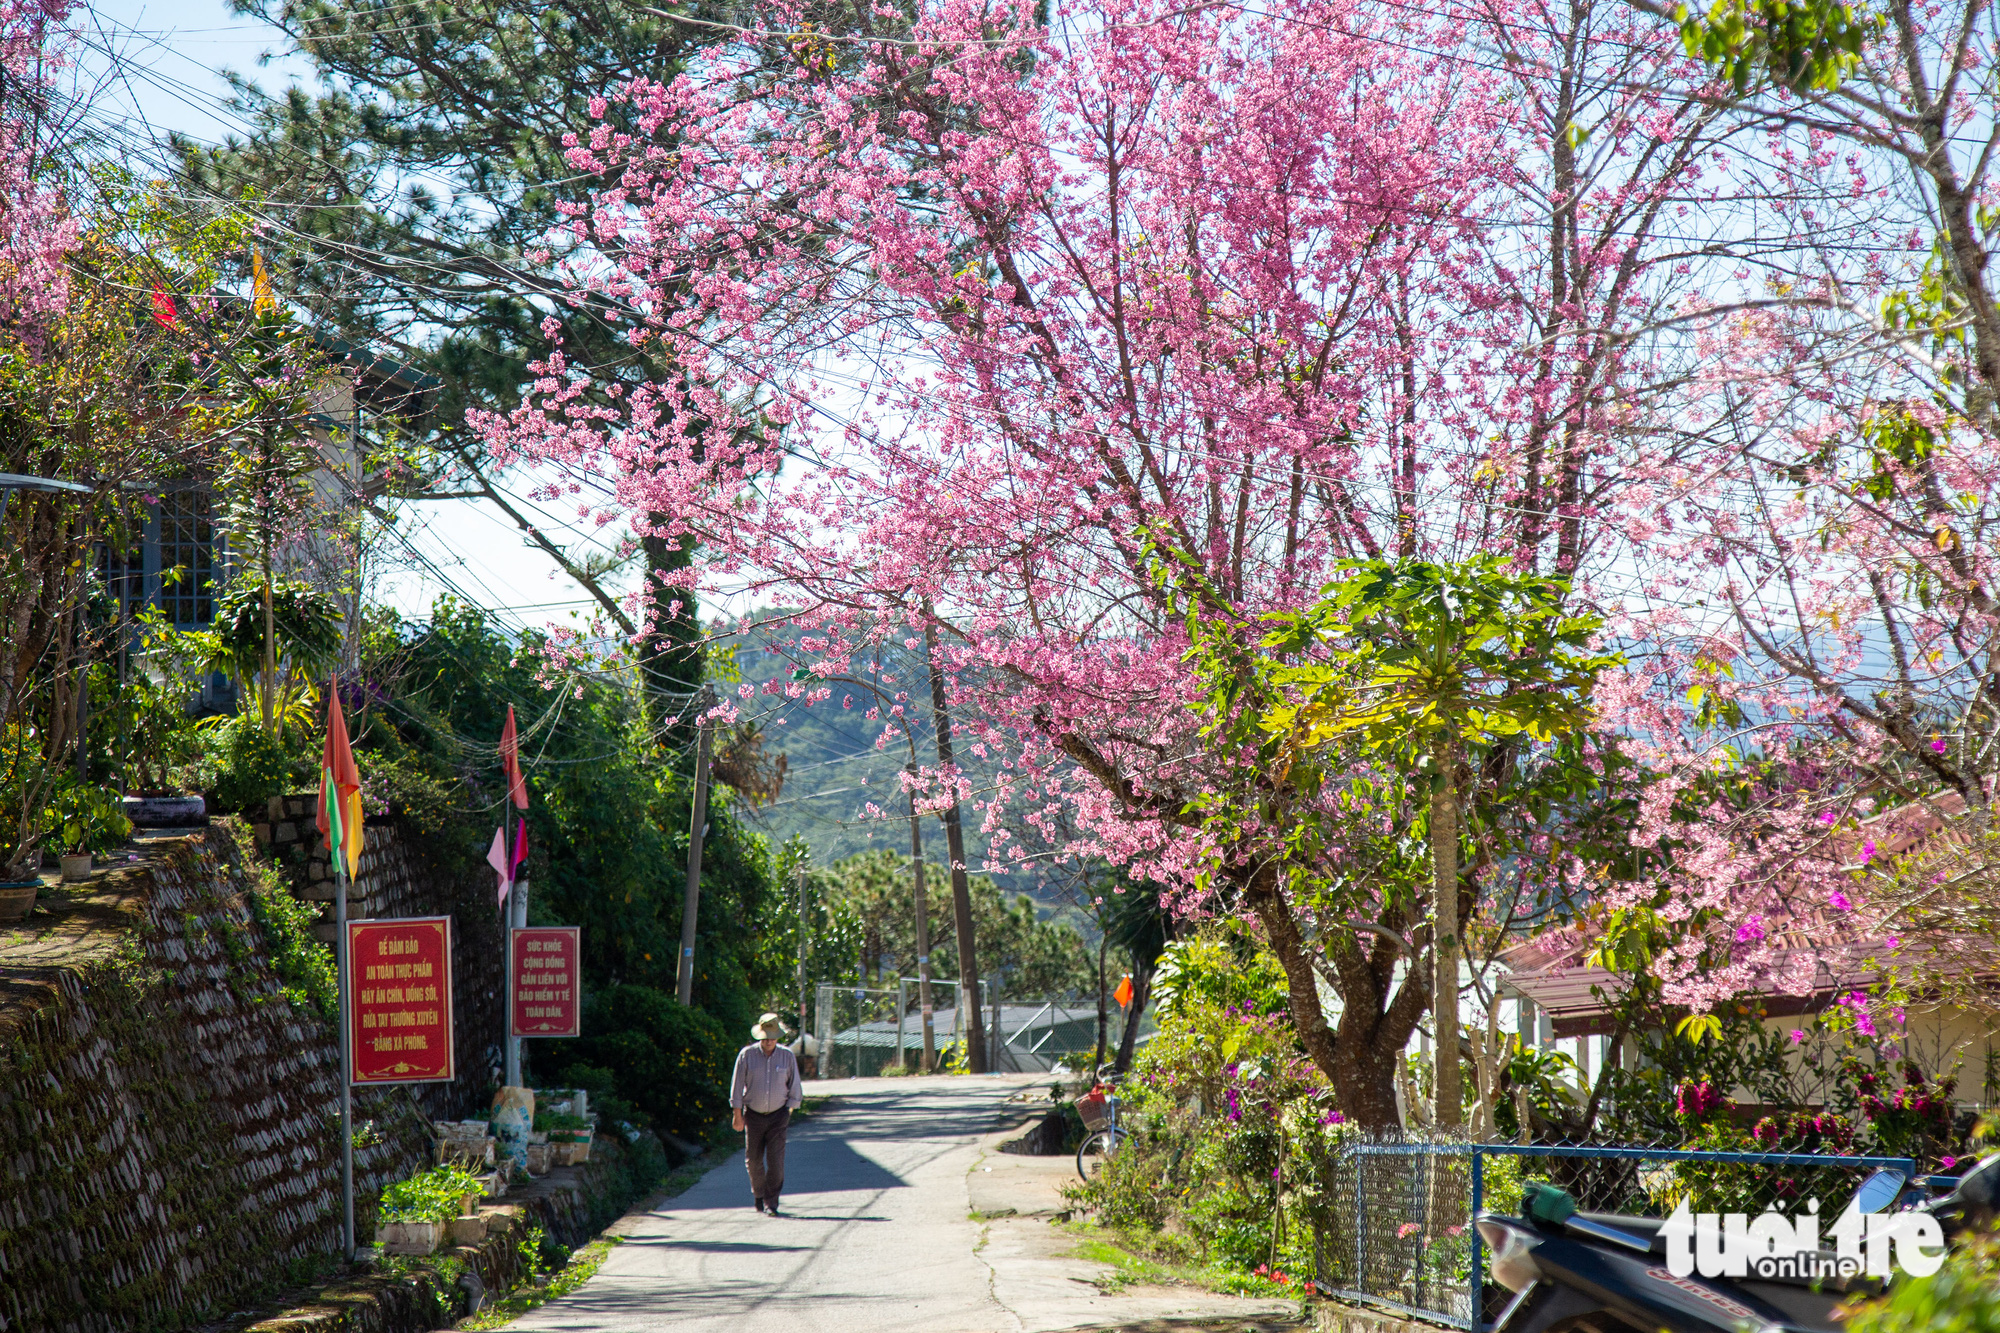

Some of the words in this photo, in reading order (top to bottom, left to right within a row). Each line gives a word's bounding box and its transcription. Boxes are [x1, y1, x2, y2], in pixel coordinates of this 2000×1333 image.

[405, 935, 418, 954] BẢO
[366, 965, 376, 980] AN
[377, 962, 394, 979] TOÀN
[395, 962, 412, 981] THỰC
[555, 991, 560, 1001] Y
[378, 1013, 388, 1027] TAY
